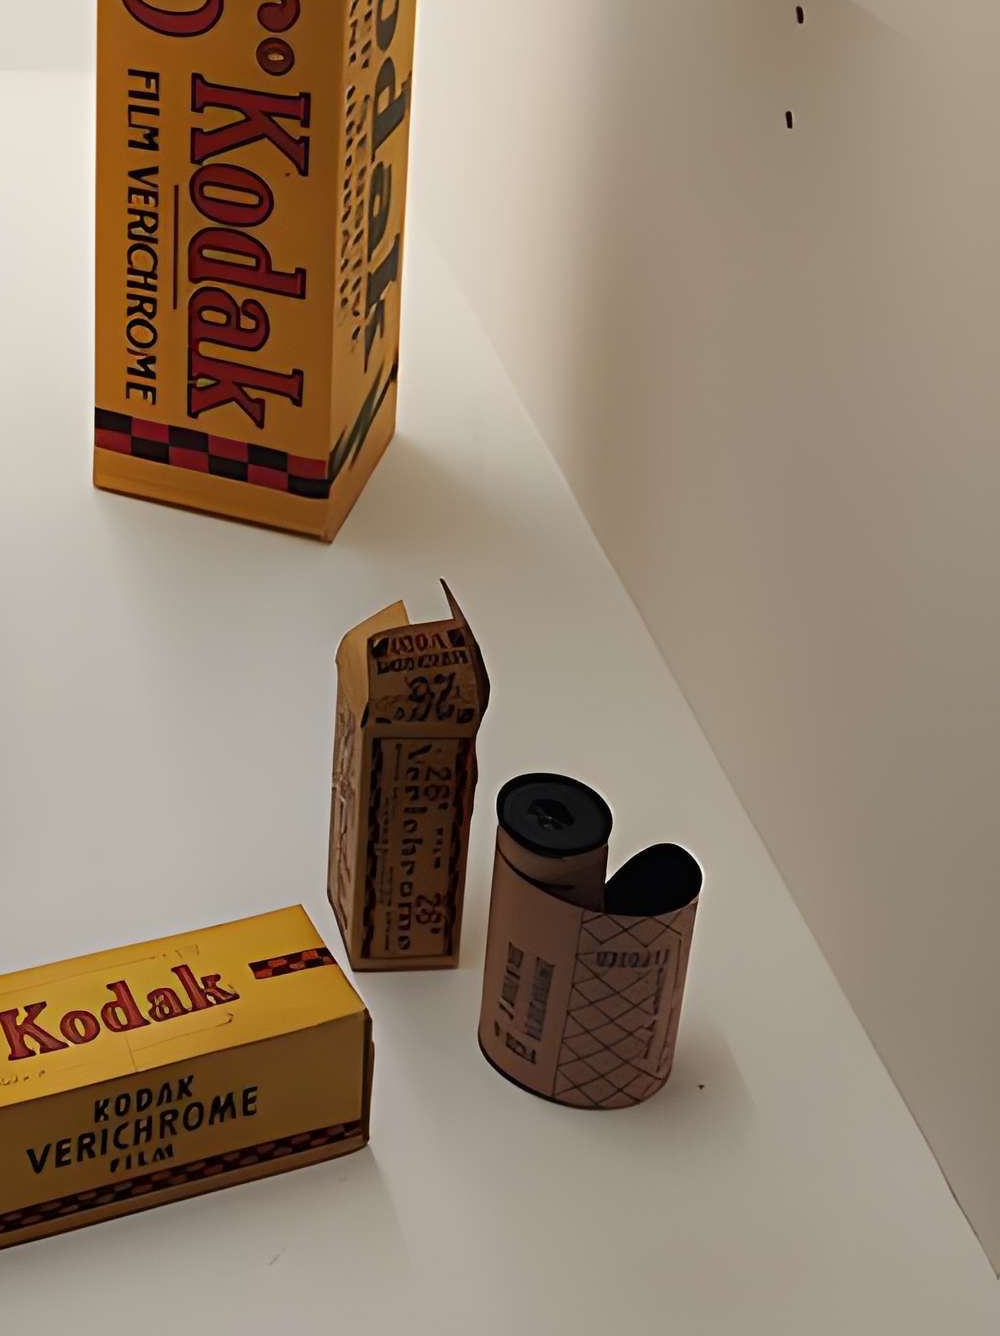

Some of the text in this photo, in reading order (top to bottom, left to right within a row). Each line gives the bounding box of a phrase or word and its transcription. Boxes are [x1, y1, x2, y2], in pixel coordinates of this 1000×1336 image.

[124, 68, 161, 406] FILM VERICHROME
[188, 72, 312, 429] Kodak
[26, 1086, 259, 1175] VERICHROME
[94, 1074, 195, 1124] KODAK
